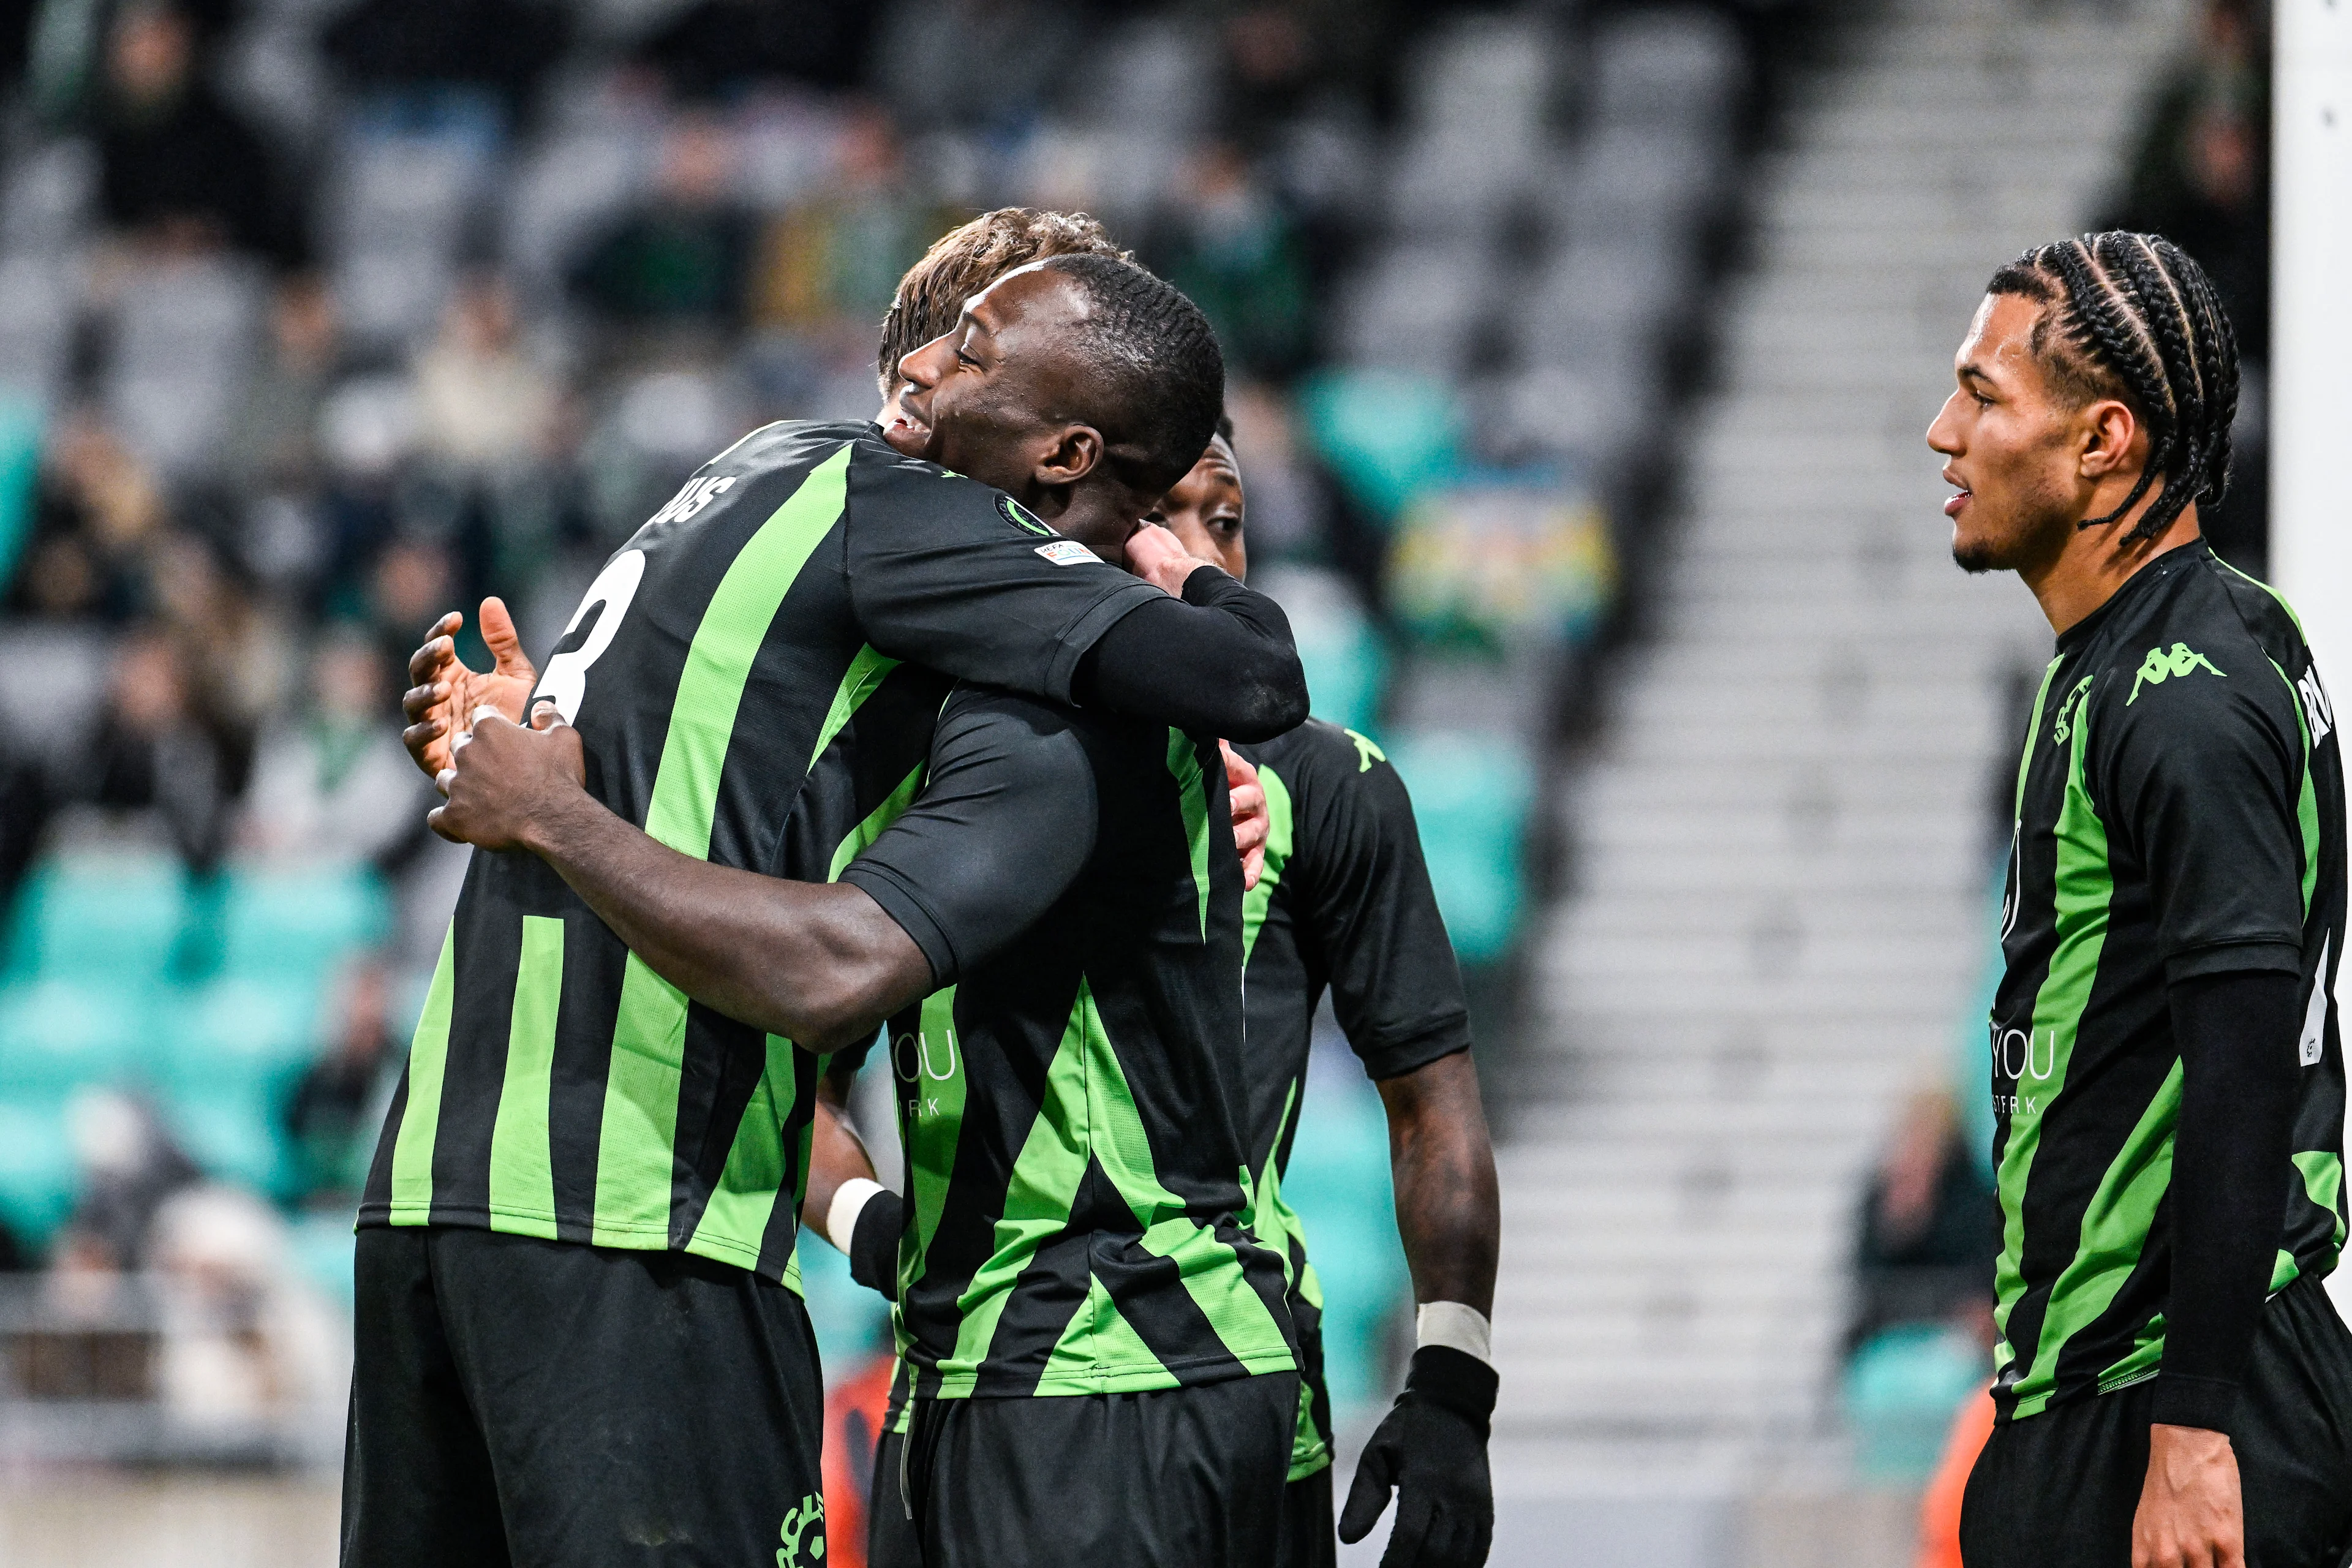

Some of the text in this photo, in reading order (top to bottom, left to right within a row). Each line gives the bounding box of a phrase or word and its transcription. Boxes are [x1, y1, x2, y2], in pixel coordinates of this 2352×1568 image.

[1040, 544, 1064, 553] UEFA
[889, 1030, 956, 1083] OU
[1992, 1028, 2055, 1080] YOU
